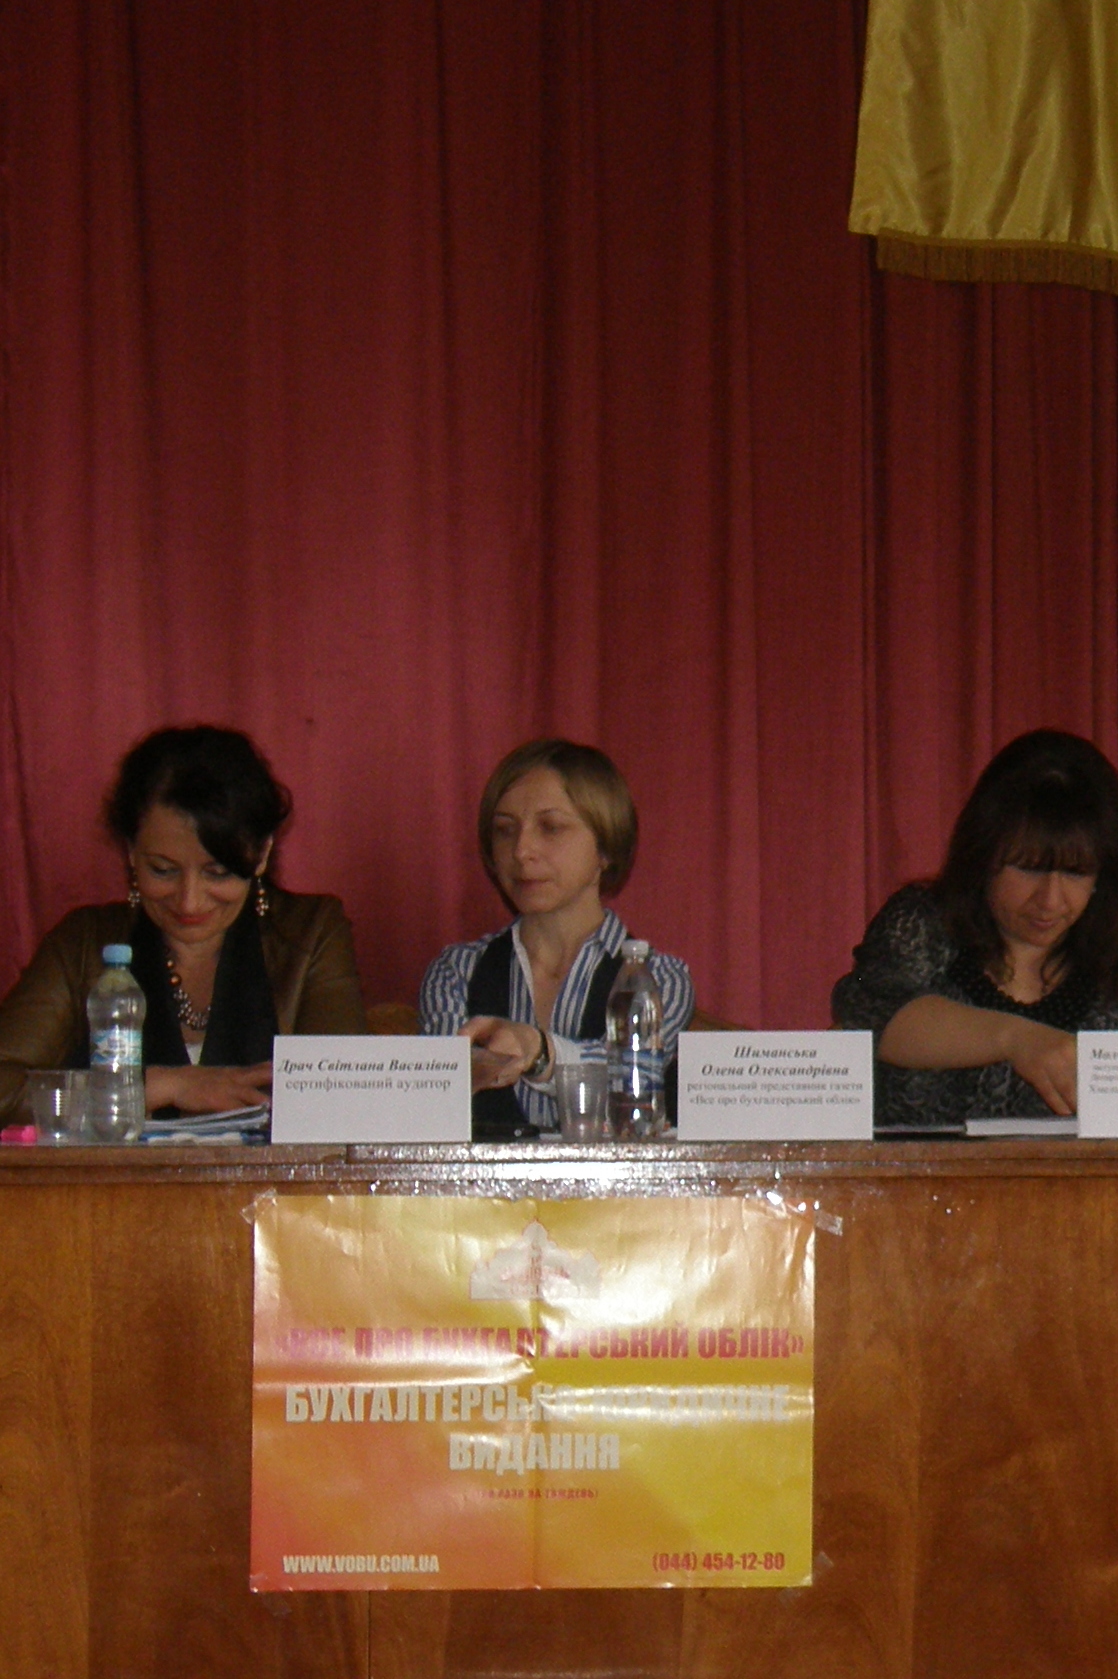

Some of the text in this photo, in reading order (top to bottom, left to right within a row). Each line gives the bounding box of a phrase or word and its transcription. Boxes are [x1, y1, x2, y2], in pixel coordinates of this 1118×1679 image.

[733, 1046, 817, 1058] Шиманська
[278, 1058, 459, 1074] Драч Світлана Василівна
[701, 1063, 849, 1078] Олена Олександрівна
[285, 1077, 451, 1092] сертифікований аудитор
[697, 1327, 804, 1359] ОБЛІК»
[450, 1433, 620, 1476] ВИДАННЯ
[283, 1554, 440, 1574] WWW.VOBU.COM.UA
[652, 1552, 785, 1572] (044) 454-12-80
